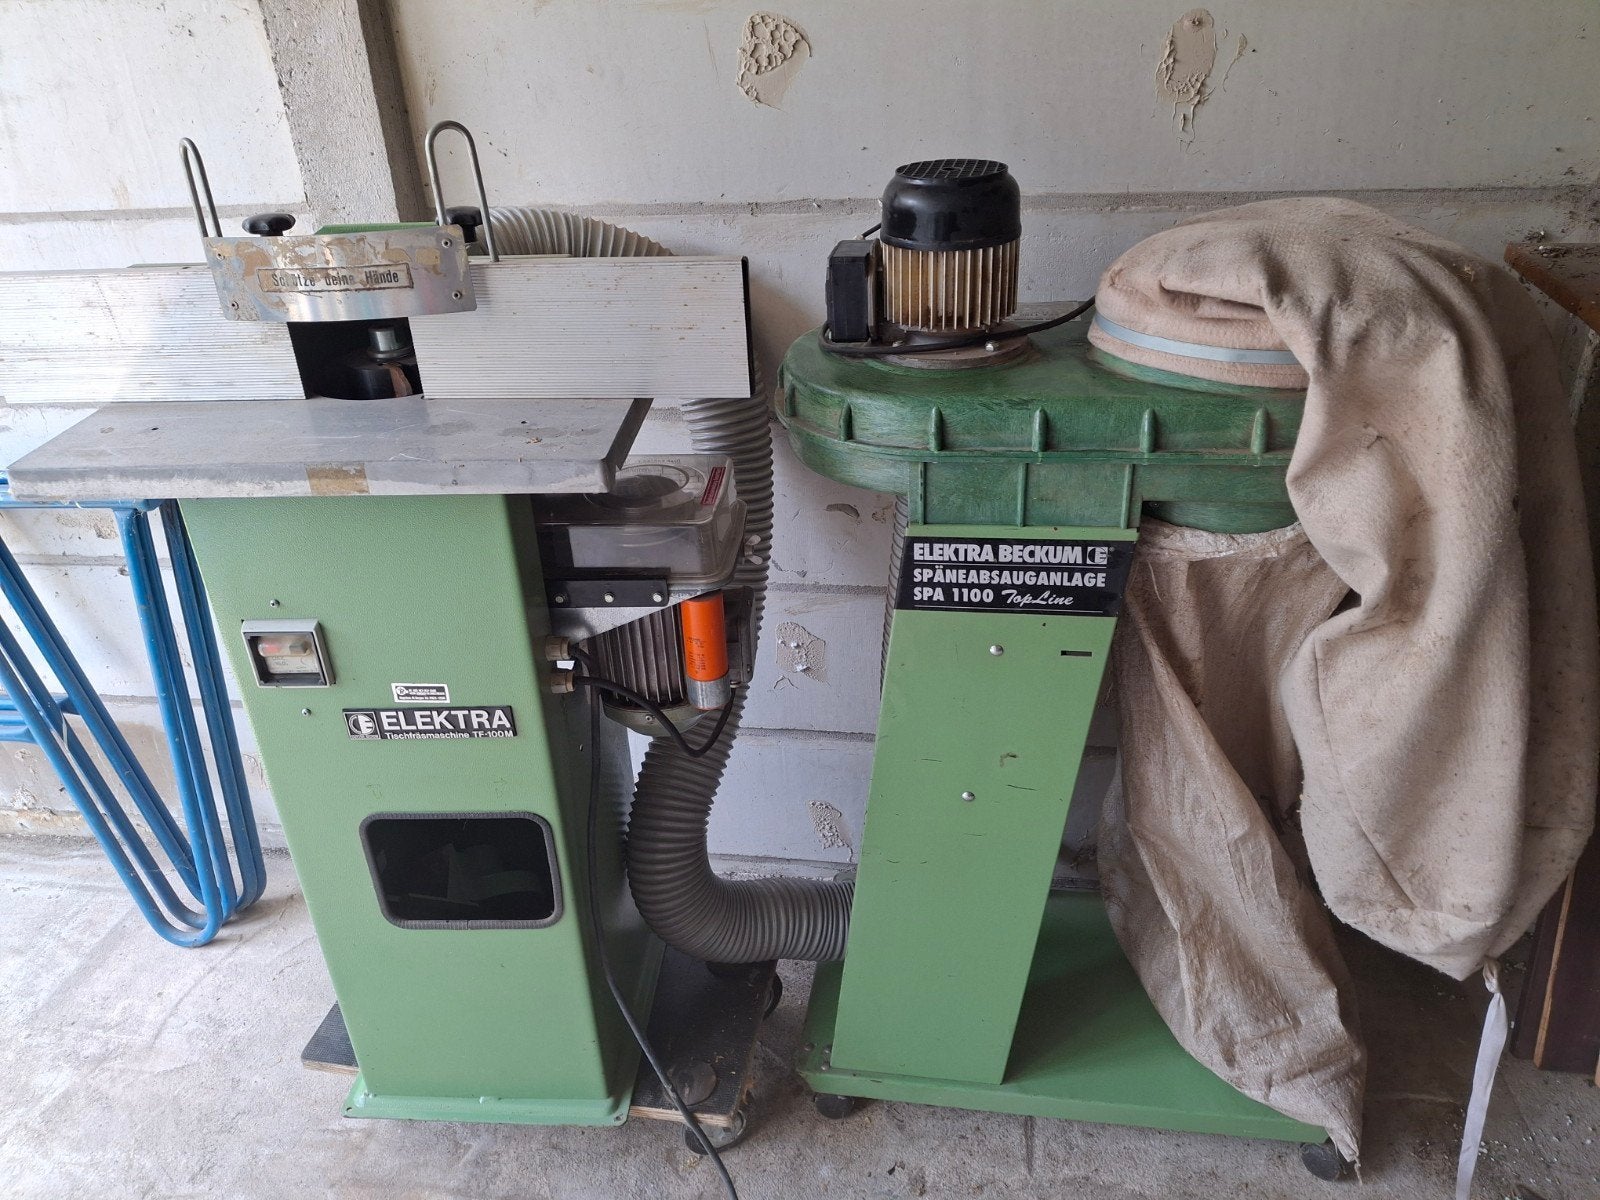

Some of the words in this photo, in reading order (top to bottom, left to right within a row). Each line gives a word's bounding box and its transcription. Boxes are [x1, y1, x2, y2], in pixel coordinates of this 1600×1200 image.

[364, 270, 399, 284] Hände
[913, 543, 994, 561] ELEKTRA
[998, 545, 1082, 564] BECKUM
[913, 566, 1106, 587] SPÄNEABSAUGANLAGE
[913, 587, 945, 601] SPA
[952, 588, 994, 603] 1100
[379, 709, 511, 730] ELEKTRA
[385, 731, 469, 739] Tischfräsmaschine
